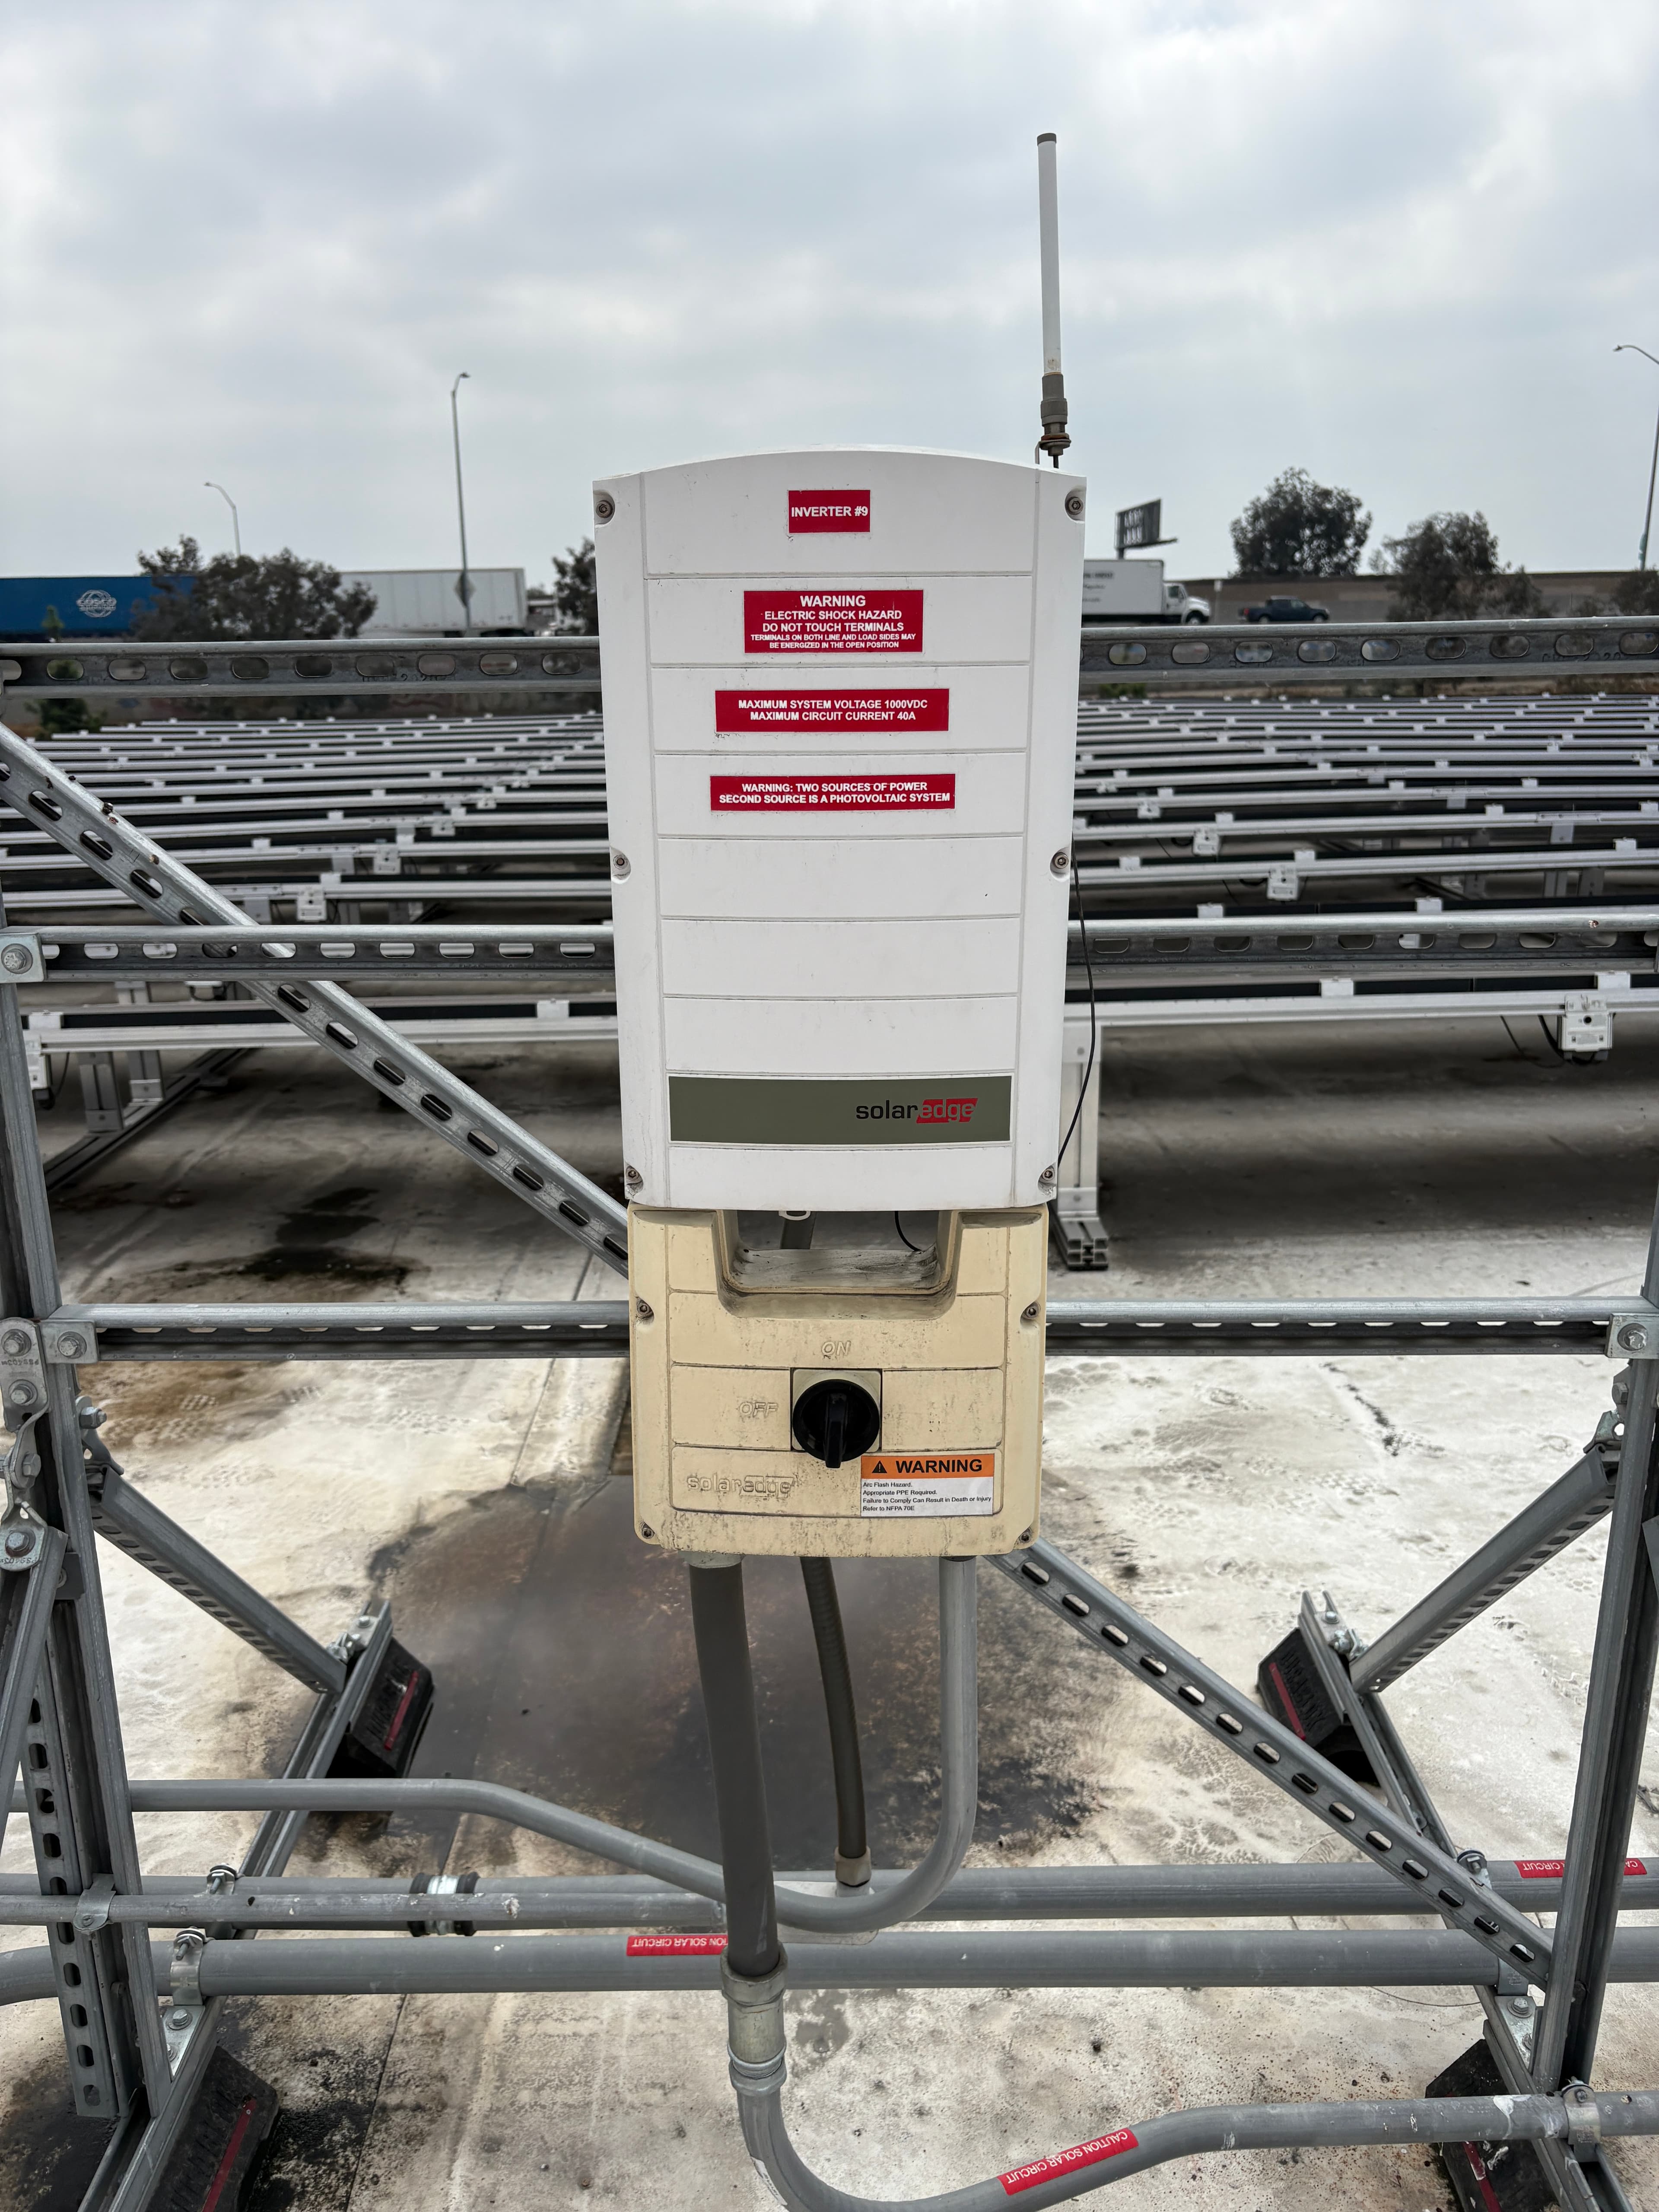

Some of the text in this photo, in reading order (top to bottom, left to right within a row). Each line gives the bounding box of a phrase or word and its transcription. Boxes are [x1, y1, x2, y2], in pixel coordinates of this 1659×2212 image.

[791, 505, 868, 517] INVERTER #9
[800, 595, 866, 607] WARNING
[765, 610, 902, 620] ELECTRIC SHOCK HAZARD
[763, 622, 904, 632] DO NOT TOUCH TERMINALS
[738, 699, 928, 709] MAXIMUM SYSTEM VOLTAGE 1000VDC
[750, 711, 916, 721] MAXIMUM CIRCUIT CURRENT 40A
[742, 782, 928, 792] WARNING: TWO SOURCES OF POWER
[719, 792, 950, 804] SECOND SOURCE IS A PHOTOVOLTAIC SYSTEM
[822, 1341, 851, 1356] ON
[739, 1402, 778, 1417] OFF
[896, 1459, 982, 1474] WARNING
[1522, 1862, 1560, 1871] CIRCUIT
[632, 1937, 728, 1947] TION SOLAR CIRCUIT
[1006, 2131, 1128, 2184] CAUTION SOLAR CIRCUIT
